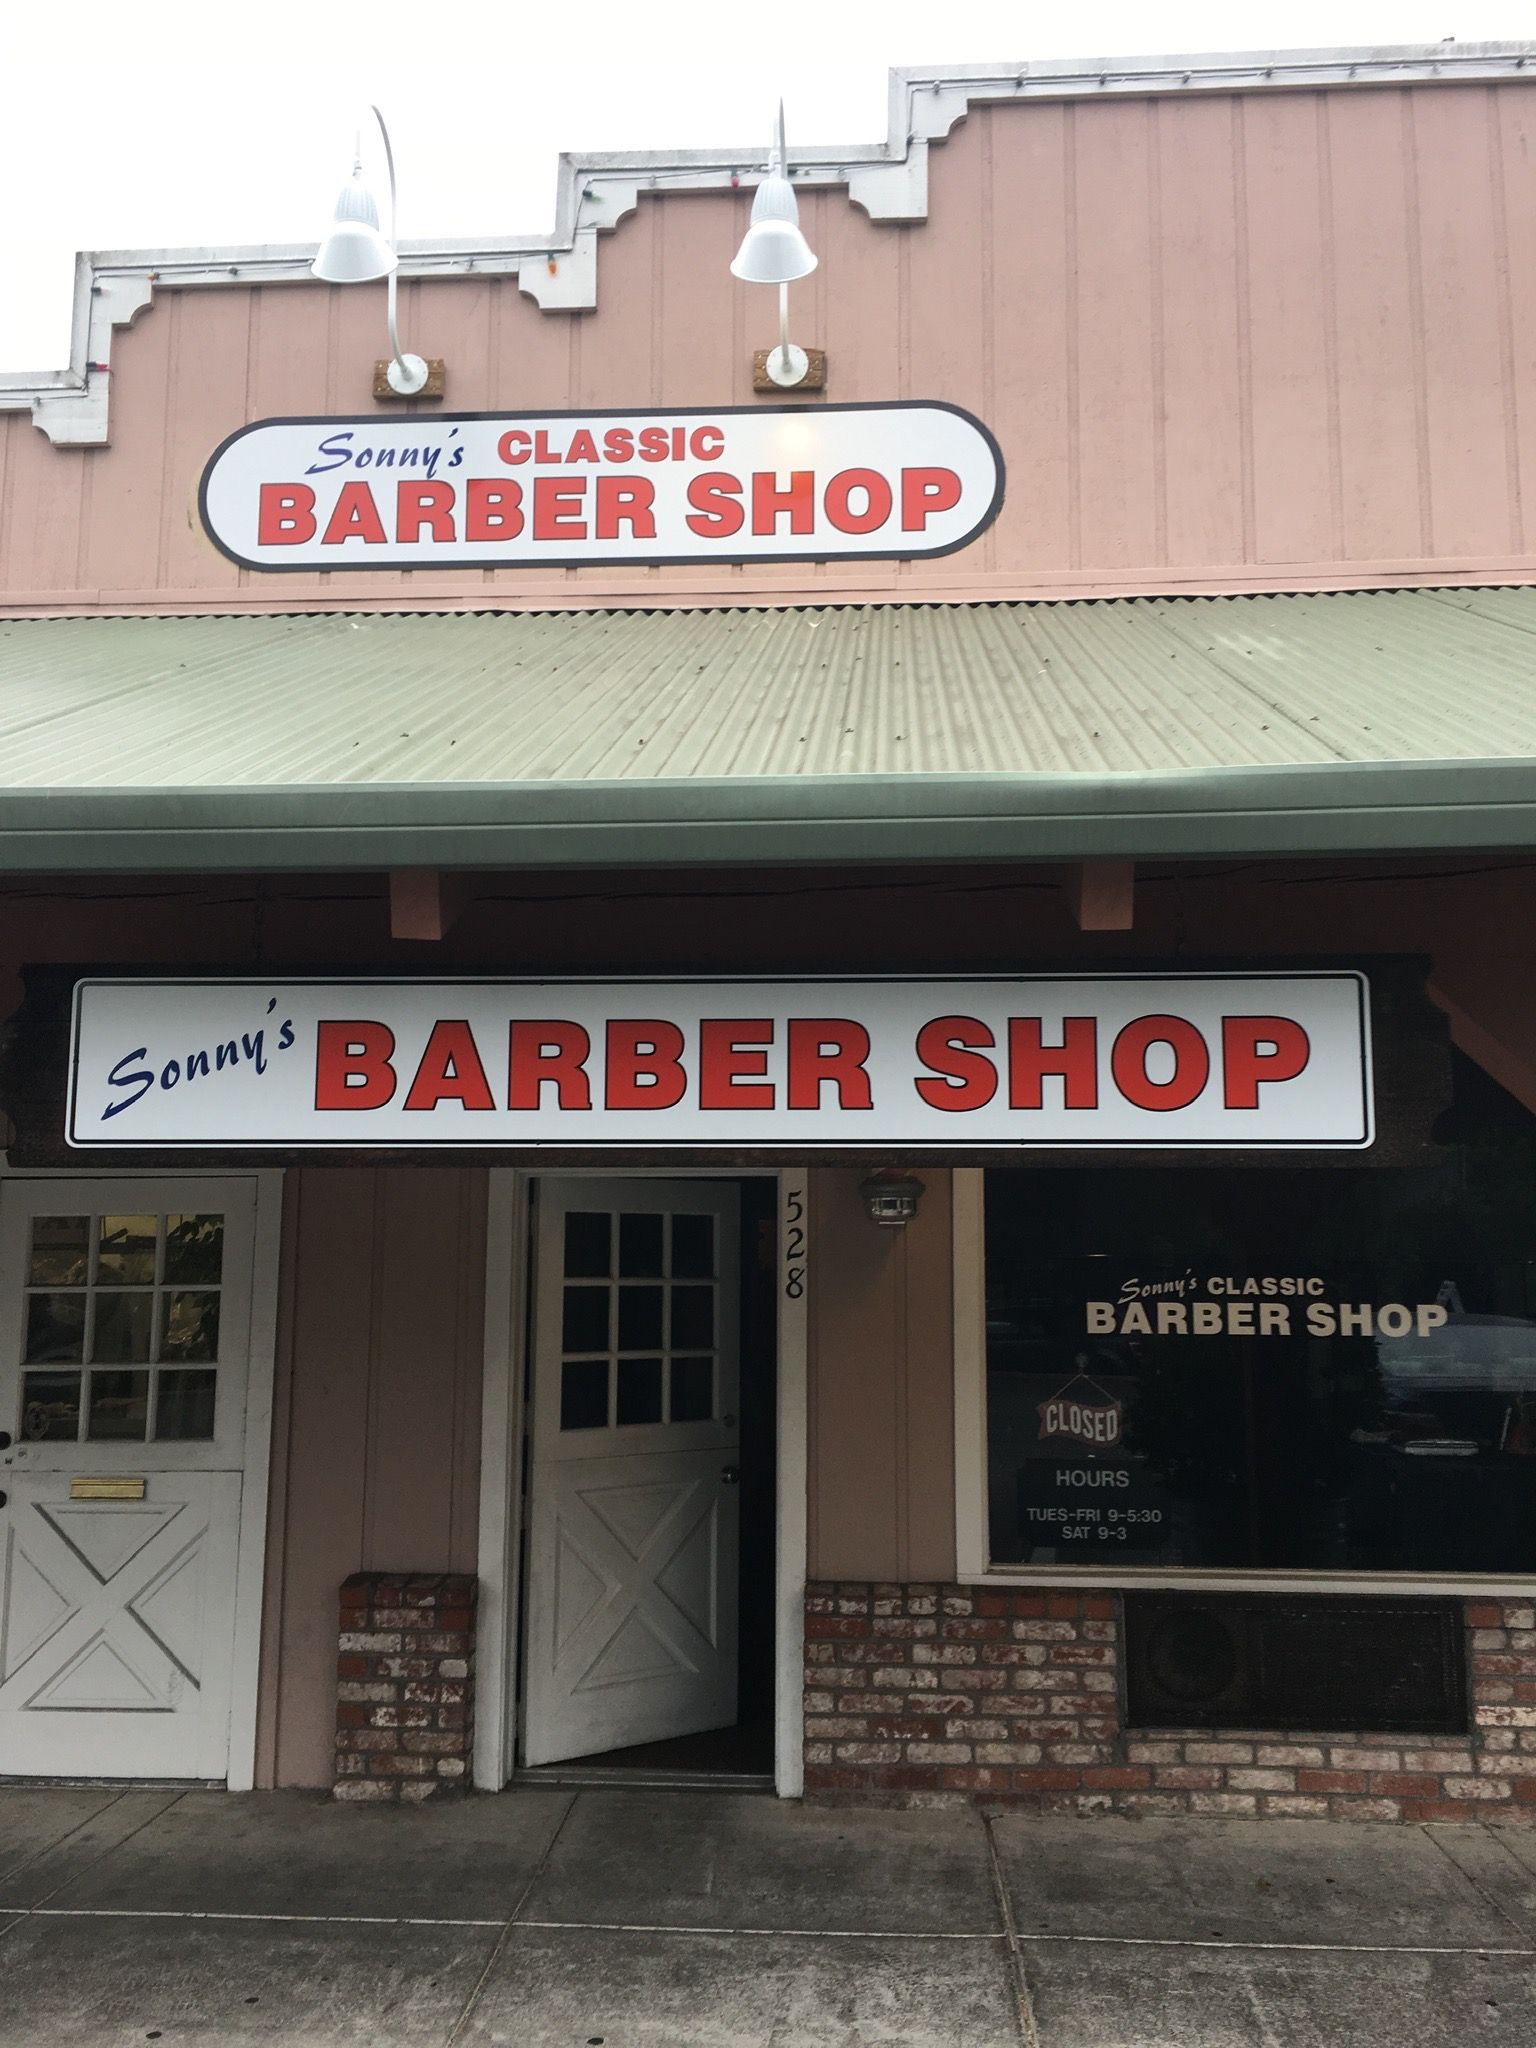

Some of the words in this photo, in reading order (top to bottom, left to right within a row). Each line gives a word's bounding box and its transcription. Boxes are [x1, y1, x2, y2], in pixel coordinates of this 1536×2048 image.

[304, 428, 464, 479] Sonny's
[497, 425, 725, 466] CLASSIC
[257, 475, 657, 547] BARBER
[685, 467, 963, 539] SHOP
[101, 997, 296, 1121] Sonny's
[314, 1018, 875, 1111] BARBER
[913, 1013, 1311, 1113] SHOP
[785, 1190, 805, 1299] 528
[1117, 1268, 1198, 1304] Sonny's
[1206, 1277, 1325, 1296] CLASSIC
[1086, 1301, 1292, 1336] BARBER
[1306, 1302, 1449, 1338] SHOP
[1046, 1403, 1119, 1442] CLOSED
[1056, 1470, 1130, 1488] HOURS
[1027, 1507, 1101, 1522] TUES-FRI
[1107, 1509, 1162, 1523] 9-5:30
[1062, 1526, 1091, 1540] SAT
[1098, 1527, 1127, 1540] 9-3
